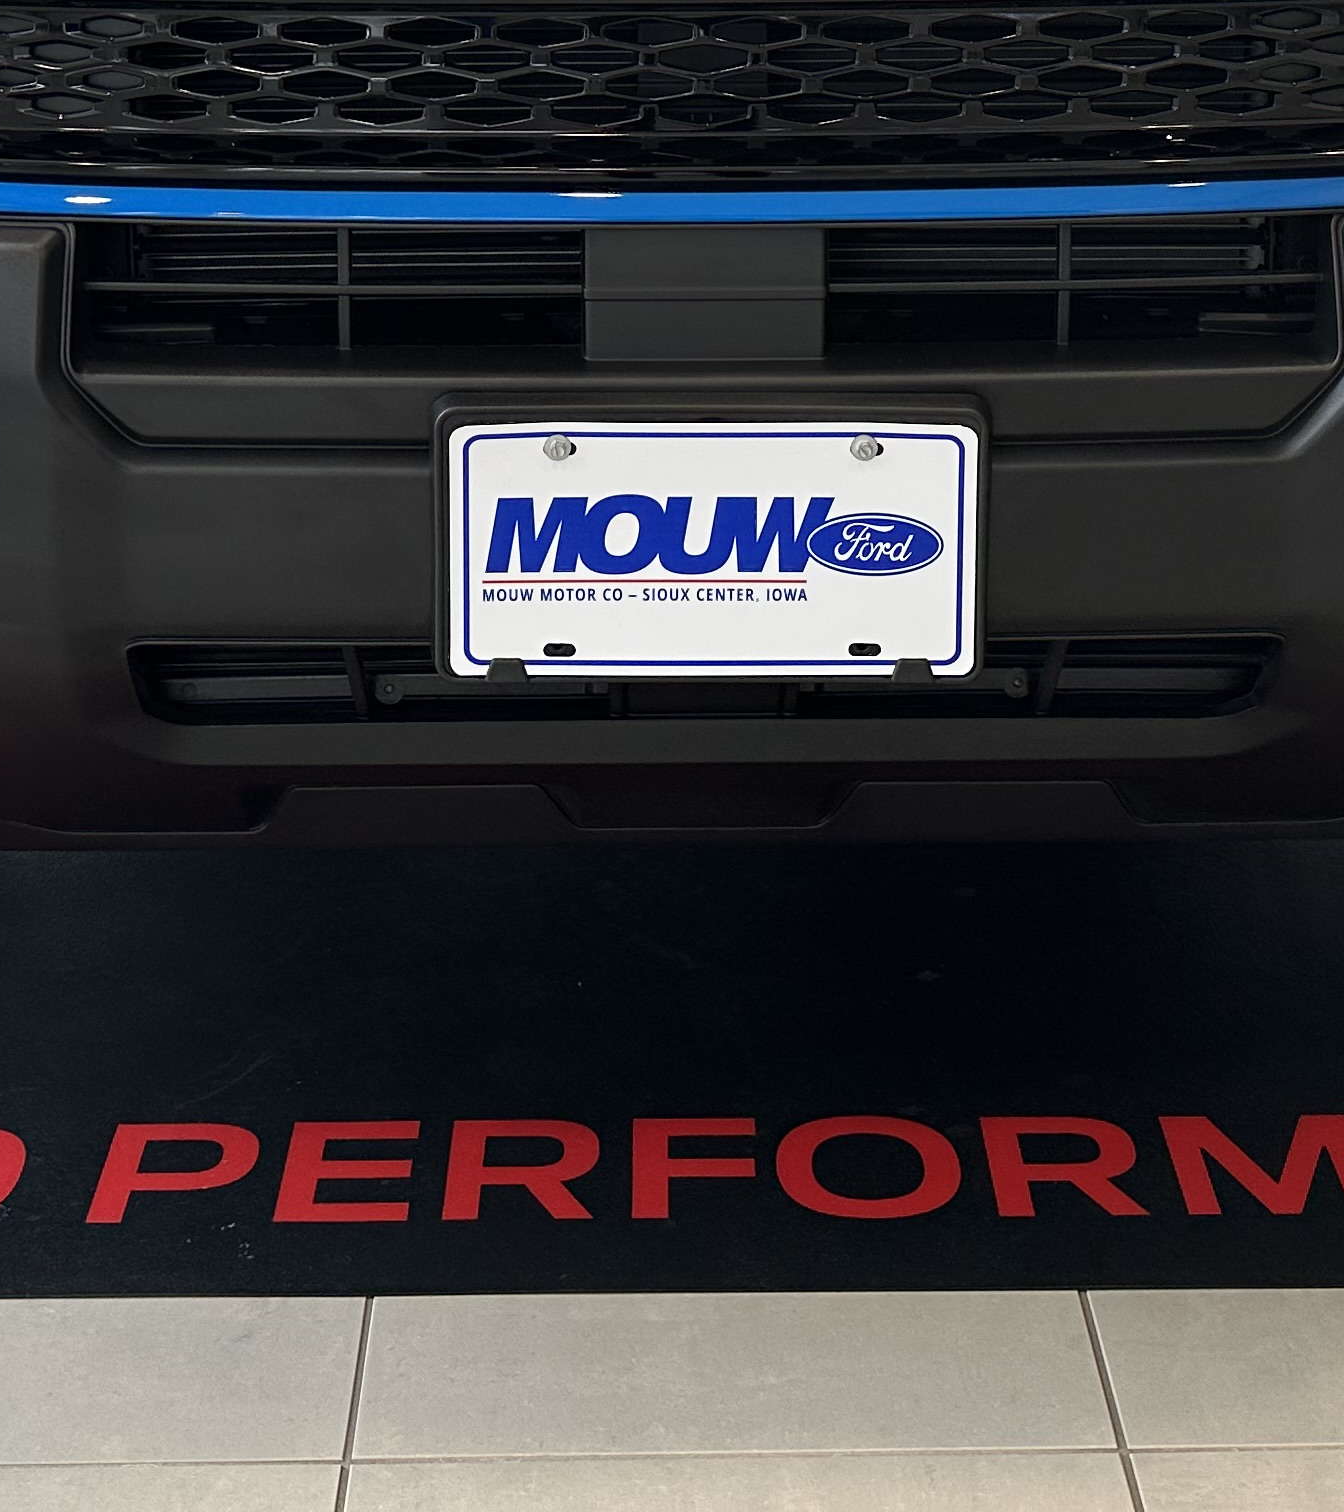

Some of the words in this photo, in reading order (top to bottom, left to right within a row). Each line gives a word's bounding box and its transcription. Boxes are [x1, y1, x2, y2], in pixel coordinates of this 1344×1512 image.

[484, 493, 836, 575] MOUW
[834, 522, 914, 563] Ford
[482, 588, 534, 602] MOUW
[540, 588, 597, 602] MOTOR
[602, 588, 623, 602] CO
[642, 588, 690, 602] SIOUX
[766, 588, 808, 602] IOWA
